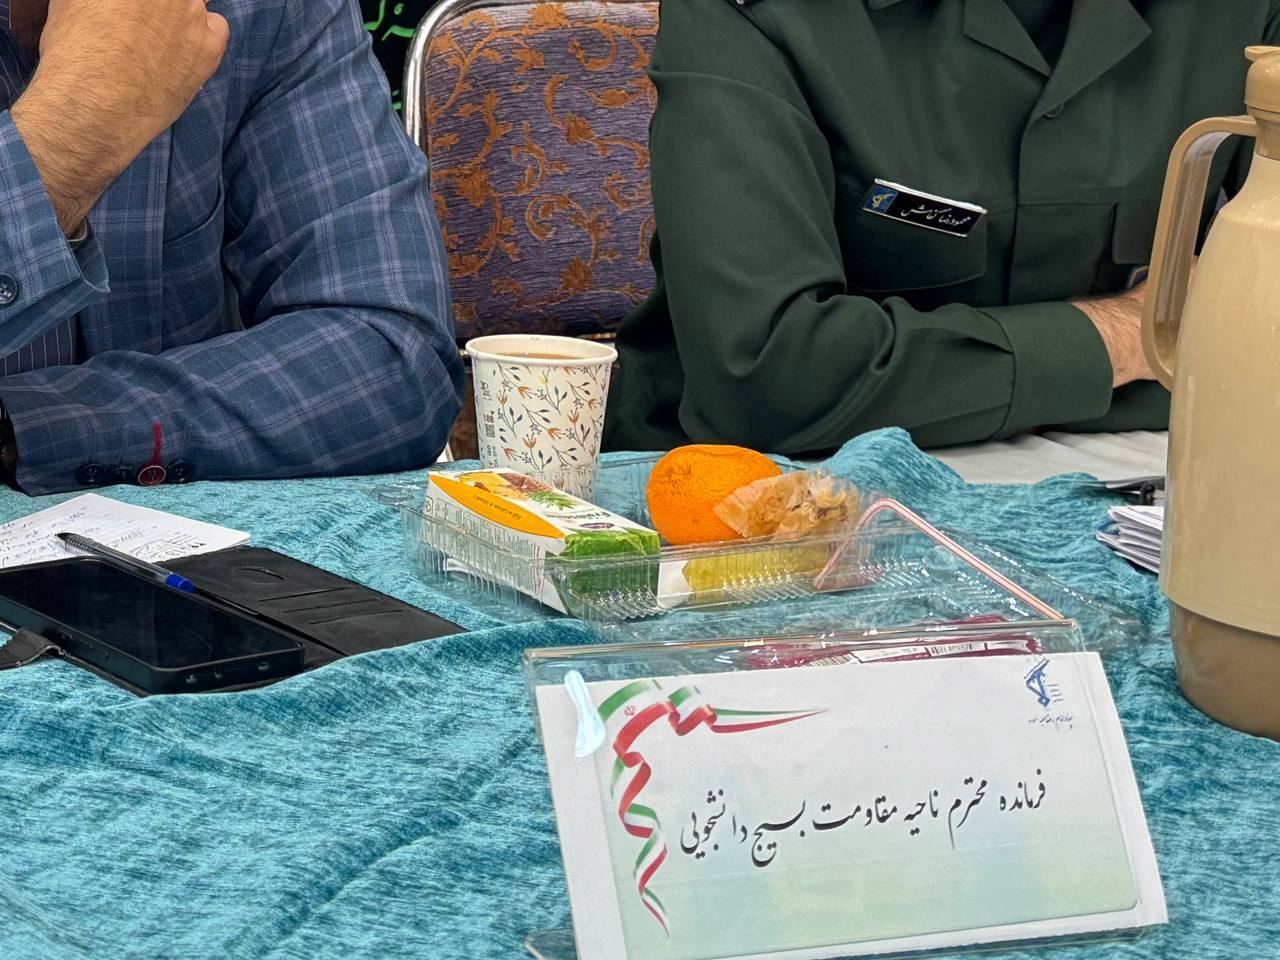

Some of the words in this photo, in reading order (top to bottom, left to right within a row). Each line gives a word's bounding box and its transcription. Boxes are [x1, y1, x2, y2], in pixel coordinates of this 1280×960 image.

[812, 795, 898, 832] مقاومت
[903, 789, 939, 836] ناحیه
[948, 776, 988, 851] محترم
[999, 768, 1046, 812] فرمانده
[680, 788, 748, 860] دانشجویی
[750, 800, 806, 868] بسیج
